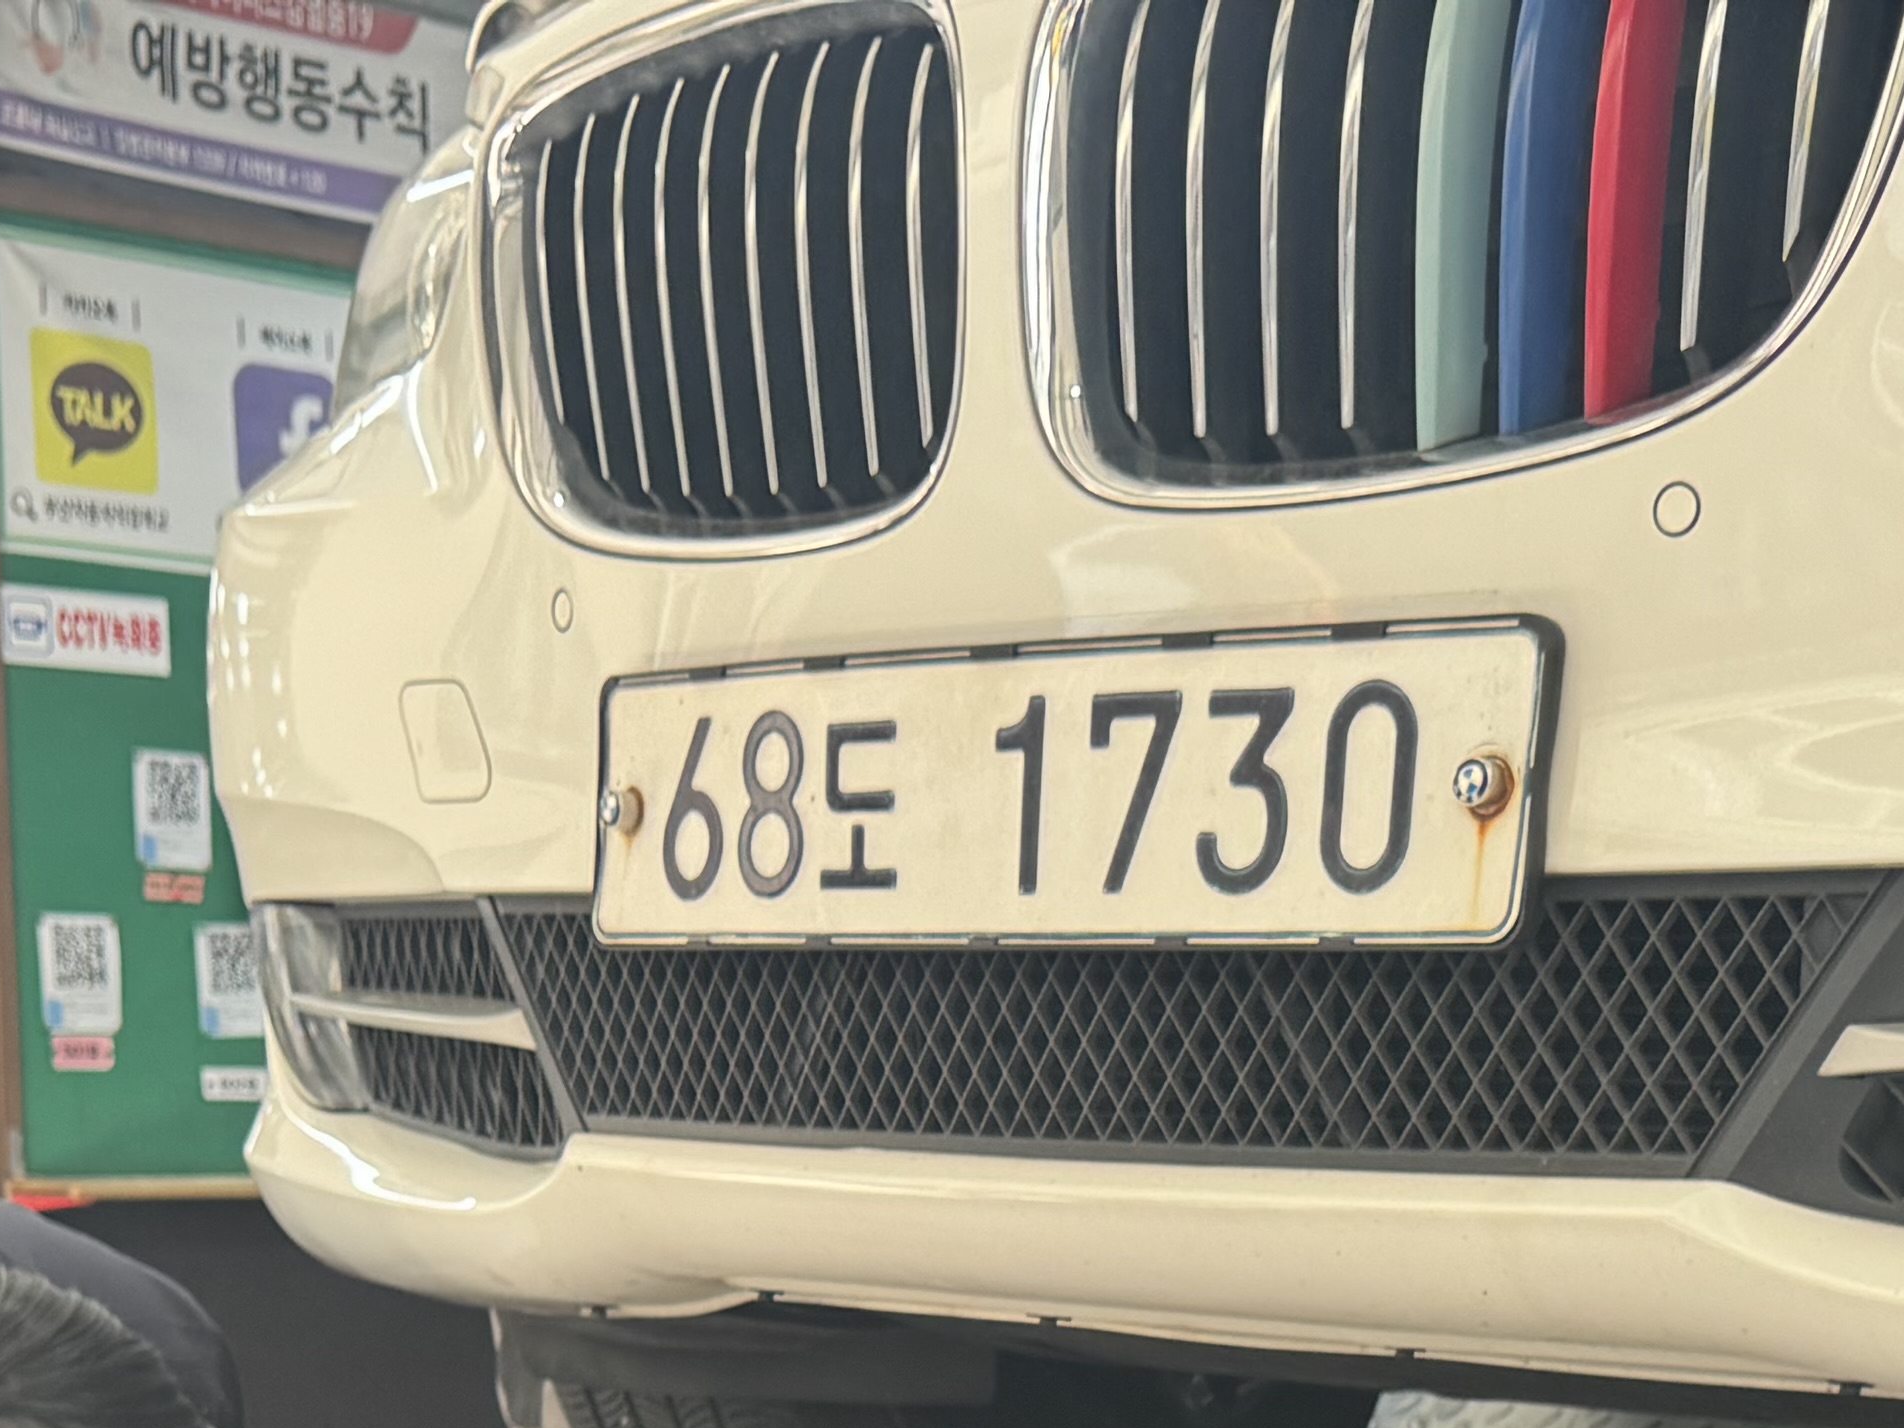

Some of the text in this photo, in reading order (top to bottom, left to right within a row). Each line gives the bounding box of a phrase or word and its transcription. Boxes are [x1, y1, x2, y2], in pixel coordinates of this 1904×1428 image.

[130, 17, 430, 155] 예방행동수칙
[55, 385, 137, 434] TALK
[659, 676, 1420, 902] 68도 1730
